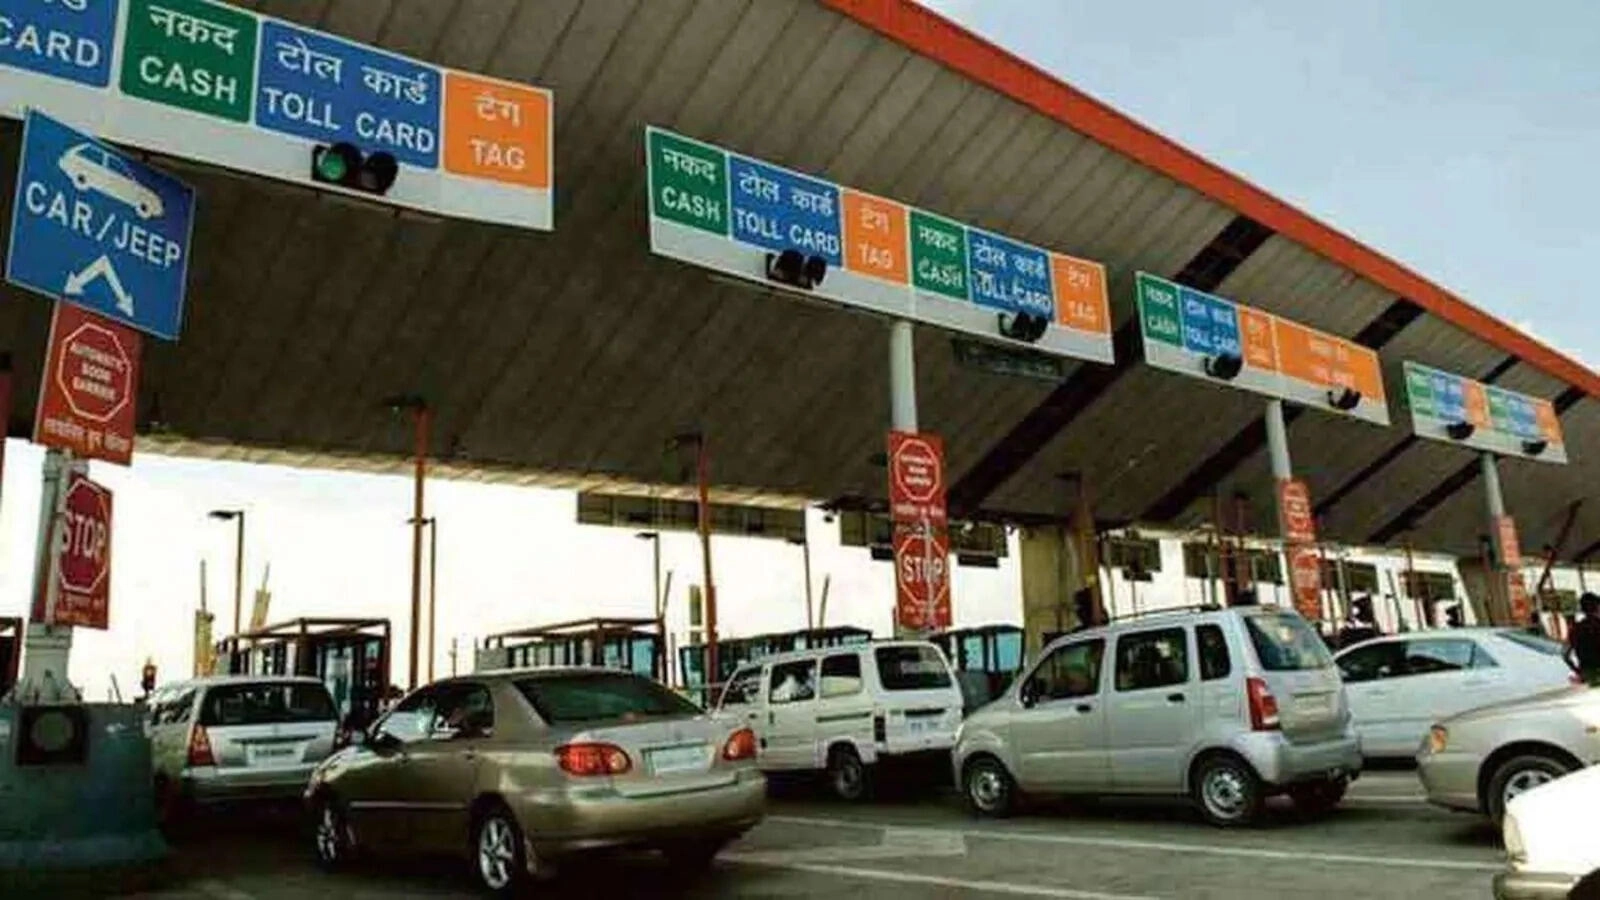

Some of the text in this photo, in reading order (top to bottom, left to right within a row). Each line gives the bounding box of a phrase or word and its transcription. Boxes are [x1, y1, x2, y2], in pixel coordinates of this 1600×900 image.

[149, 5, 239, 55] नकद
[140, 56, 237, 104] CASH
[275, 38, 430, 105] टोल कार्ड
[262, 87, 435, 152] TOLL CARD
[471, 139, 525, 170] TAG
[662, 148, 717, 184] नकद
[661, 186, 720, 222] CASH
[739, 169, 780, 203] टोल
[26, 181, 181, 268] CAR/JEEP
[734, 208, 840, 254] TOLL CARD
[858, 241, 893, 269] TAG
[918, 256, 963, 288] CASH
[61, 511, 106, 562] STOP
